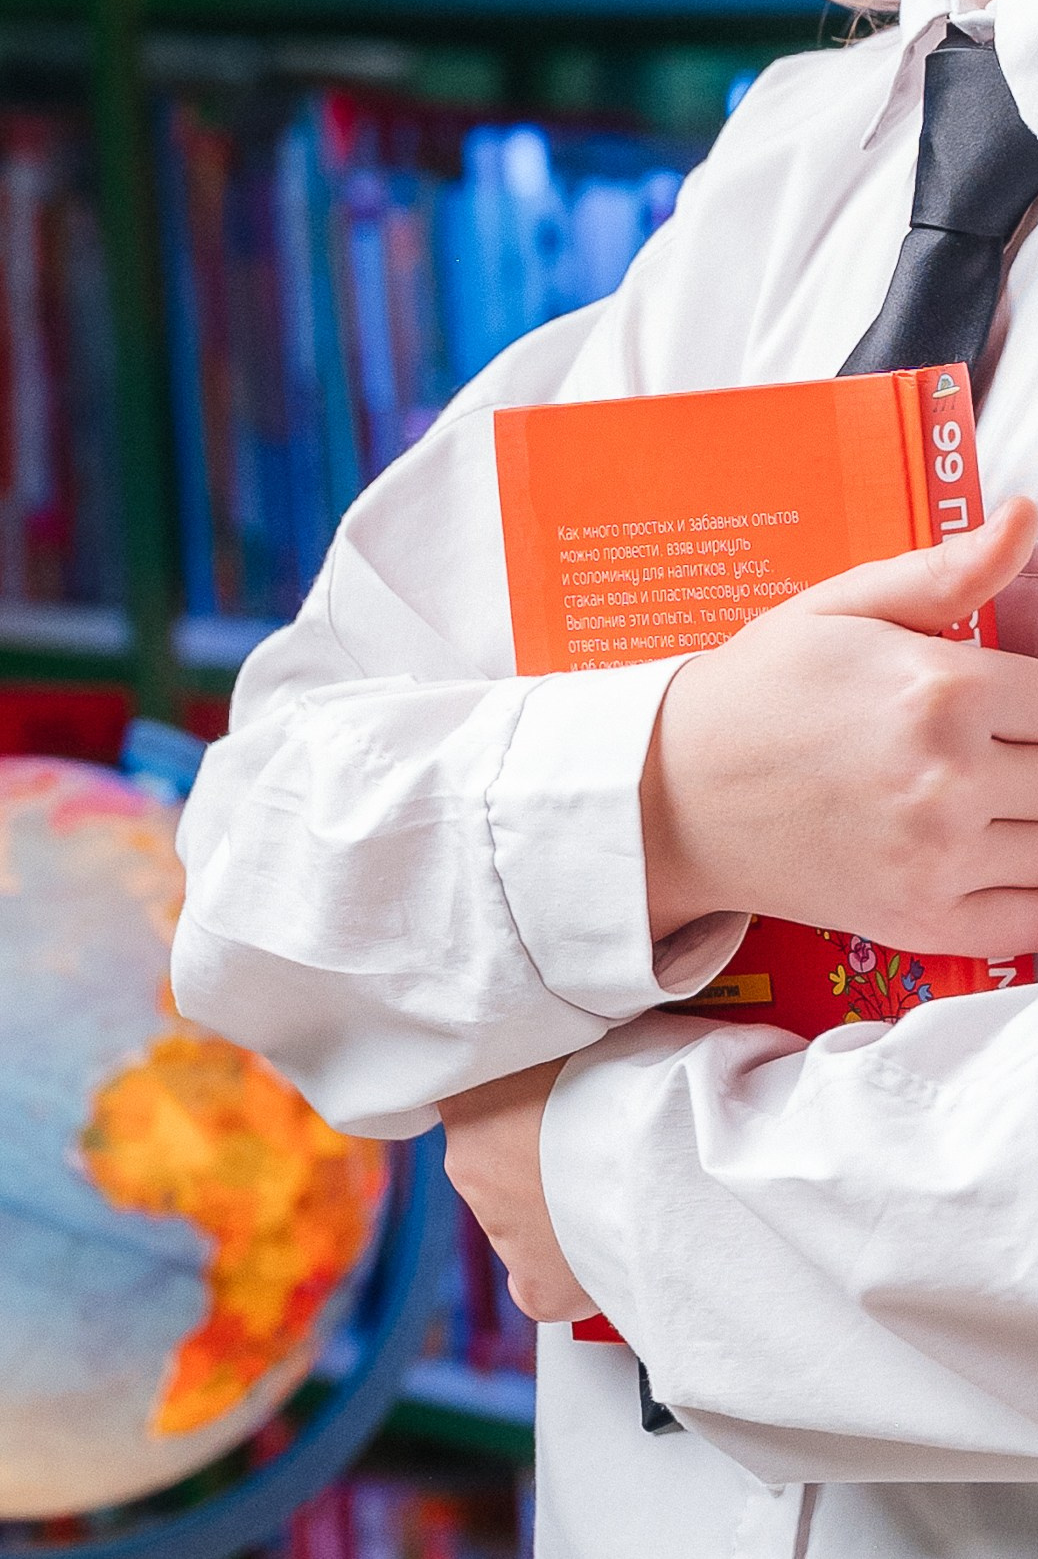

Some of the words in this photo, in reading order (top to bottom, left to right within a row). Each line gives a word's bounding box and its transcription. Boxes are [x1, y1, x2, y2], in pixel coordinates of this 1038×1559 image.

[932, 420, 964, 483] 99
[557, 525, 580, 541] Как
[583, 523, 619, 539] много
[622, 520, 674, 539] простых
[677, 519, 686, 532] и
[688, 513, 749, 532] забавных
[751, 510, 800, 527] опытов
[559, 548, 600, 563] можно
[666, 542, 694, 556] взяв
[696, 538, 752, 557] циркуль
[561, 573, 570, 586] и
[572, 569, 640, 586] соломинку
[642, 566, 665, 582] для
[563, 594, 605, 609] стакан
[607, 591, 639, 607] воды
[640, 590, 649, 604] и
[651, 583, 751, 603] пластмассовую
[565, 614, 626, 631] Выполнив
[628, 613, 650, 627] эти
[700, 608, 717, 623] ты
[568, 638, 610, 654] ответы
[613, 637, 628, 651] на
[630, 634, 675, 650] многие
